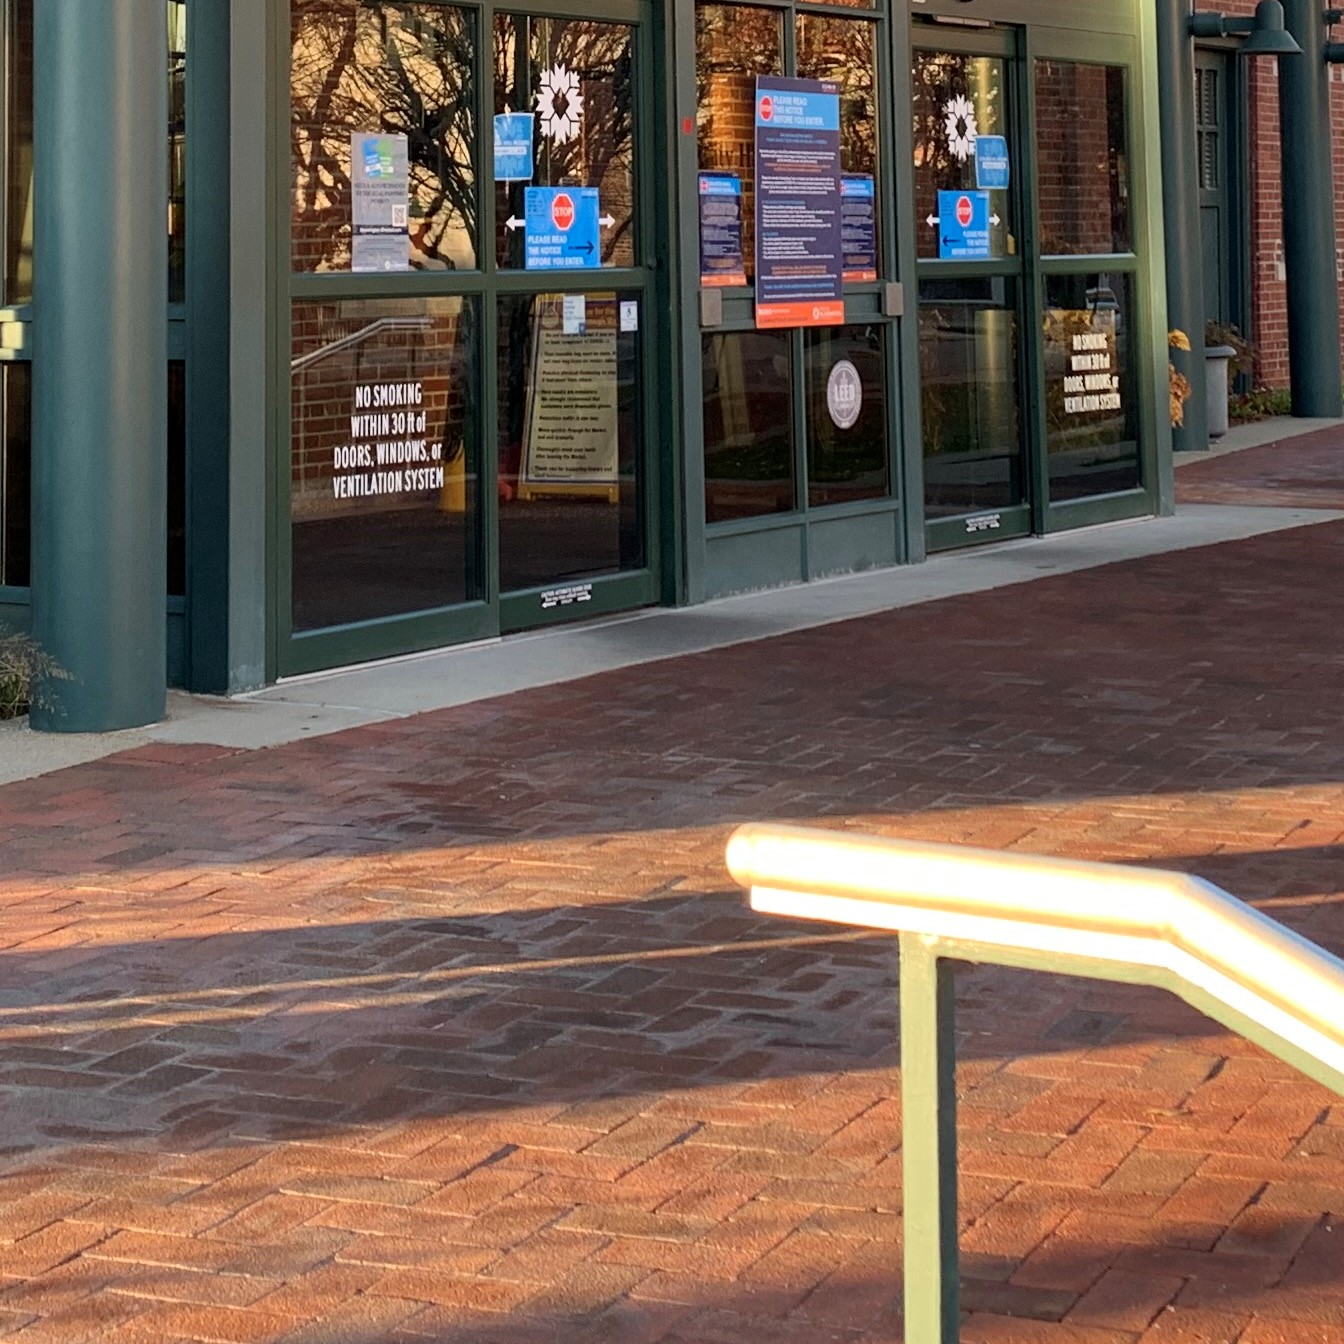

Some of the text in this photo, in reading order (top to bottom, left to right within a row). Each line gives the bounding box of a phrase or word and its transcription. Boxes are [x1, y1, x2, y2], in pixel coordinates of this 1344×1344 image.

[554, 207, 572, 217] STOP
[528, 235, 568, 244] PLEASE READ
[528, 257, 551, 266] BEFORE
[552, 257, 564, 265] YOU
[1082, 333, 1108, 350] SMOKING
[355, 383, 422, 408] NO SMOKING
[1064, 393, 1121, 413] VENTILATION SYSTEM
[351, 410, 426, 437] WITHIN 30 ft of
[333, 439, 442, 469] DOORS, WINDOWS, or
[333, 466, 444, 499] VENTILATION SYSTEM
